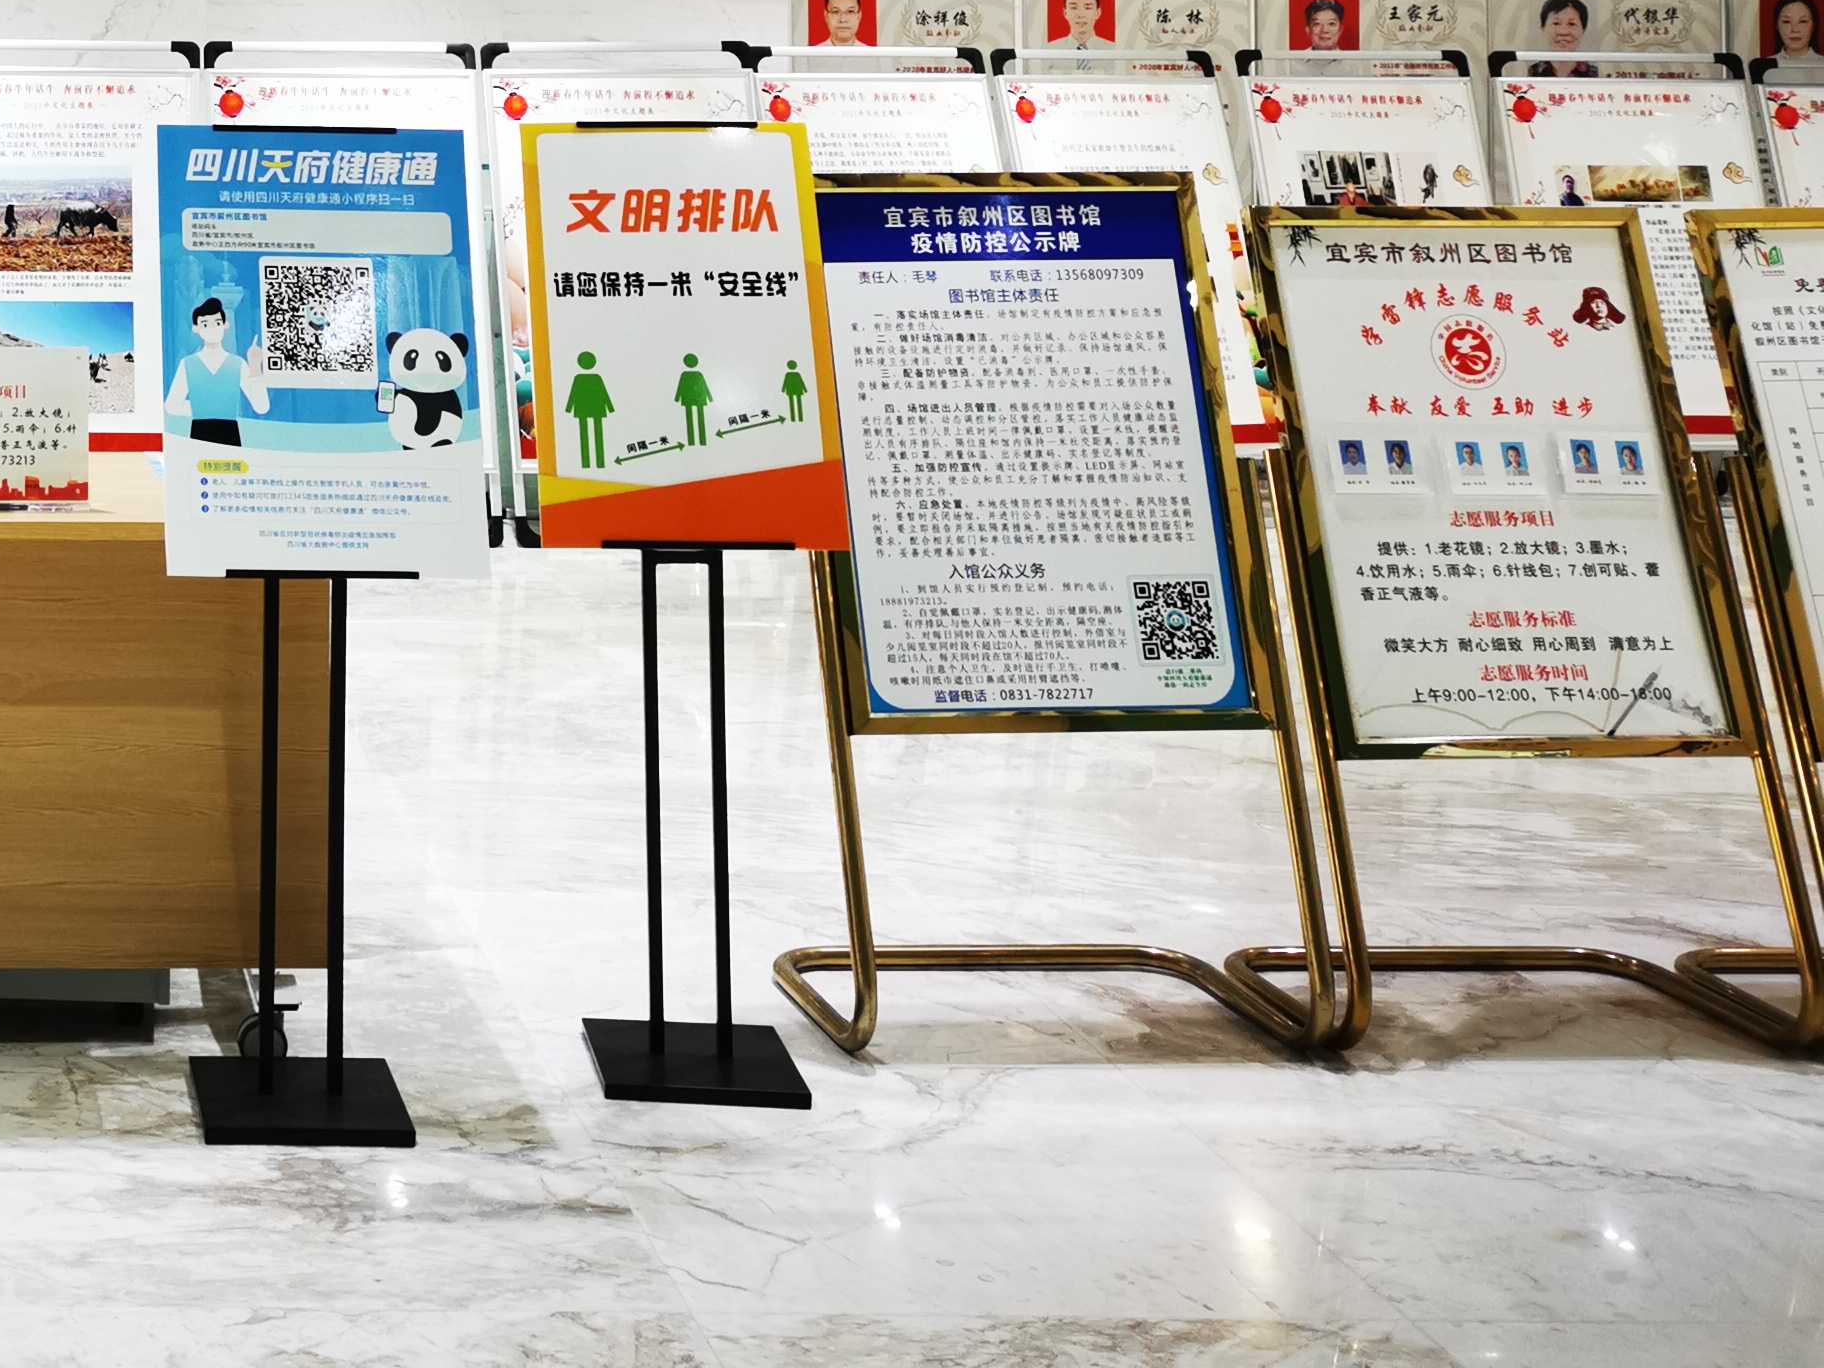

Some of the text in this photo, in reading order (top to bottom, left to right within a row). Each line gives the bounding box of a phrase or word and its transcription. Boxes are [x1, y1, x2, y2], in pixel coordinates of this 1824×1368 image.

[185, 148, 438, 186] 四川天府健康通
[219, 190, 415, 206] 请使用四川天府健康通小程序扫一扫
[566, 188, 779, 233] 文明排队
[883, 204, 1102, 229] 宜宾市叙州区图书馆
[910, 231, 1082, 255] 疫情防控公示牌
[1326, 242, 1573, 264] 宜宾市叙州区图书馆
[948, 288, 1060, 304] 图书馆主体责任
[1366, 393, 1595, 418] 奉献 友爱 互助 进步
[728, 409, 771, 427] 间隔一米
[626, 434, 671, 455] 间隔一米
[1449, 510, 1555, 527] 志愿服务项目
[949, 563, 1046, 580] 入馆公众义务
[1468, 610, 1577, 629] 志愿服务标准
[1383, 635, 1675, 654] 微笑大方 耐心细致 用心周到 满意为上
[1480, 663, 1589, 682] 志愿服务时间
